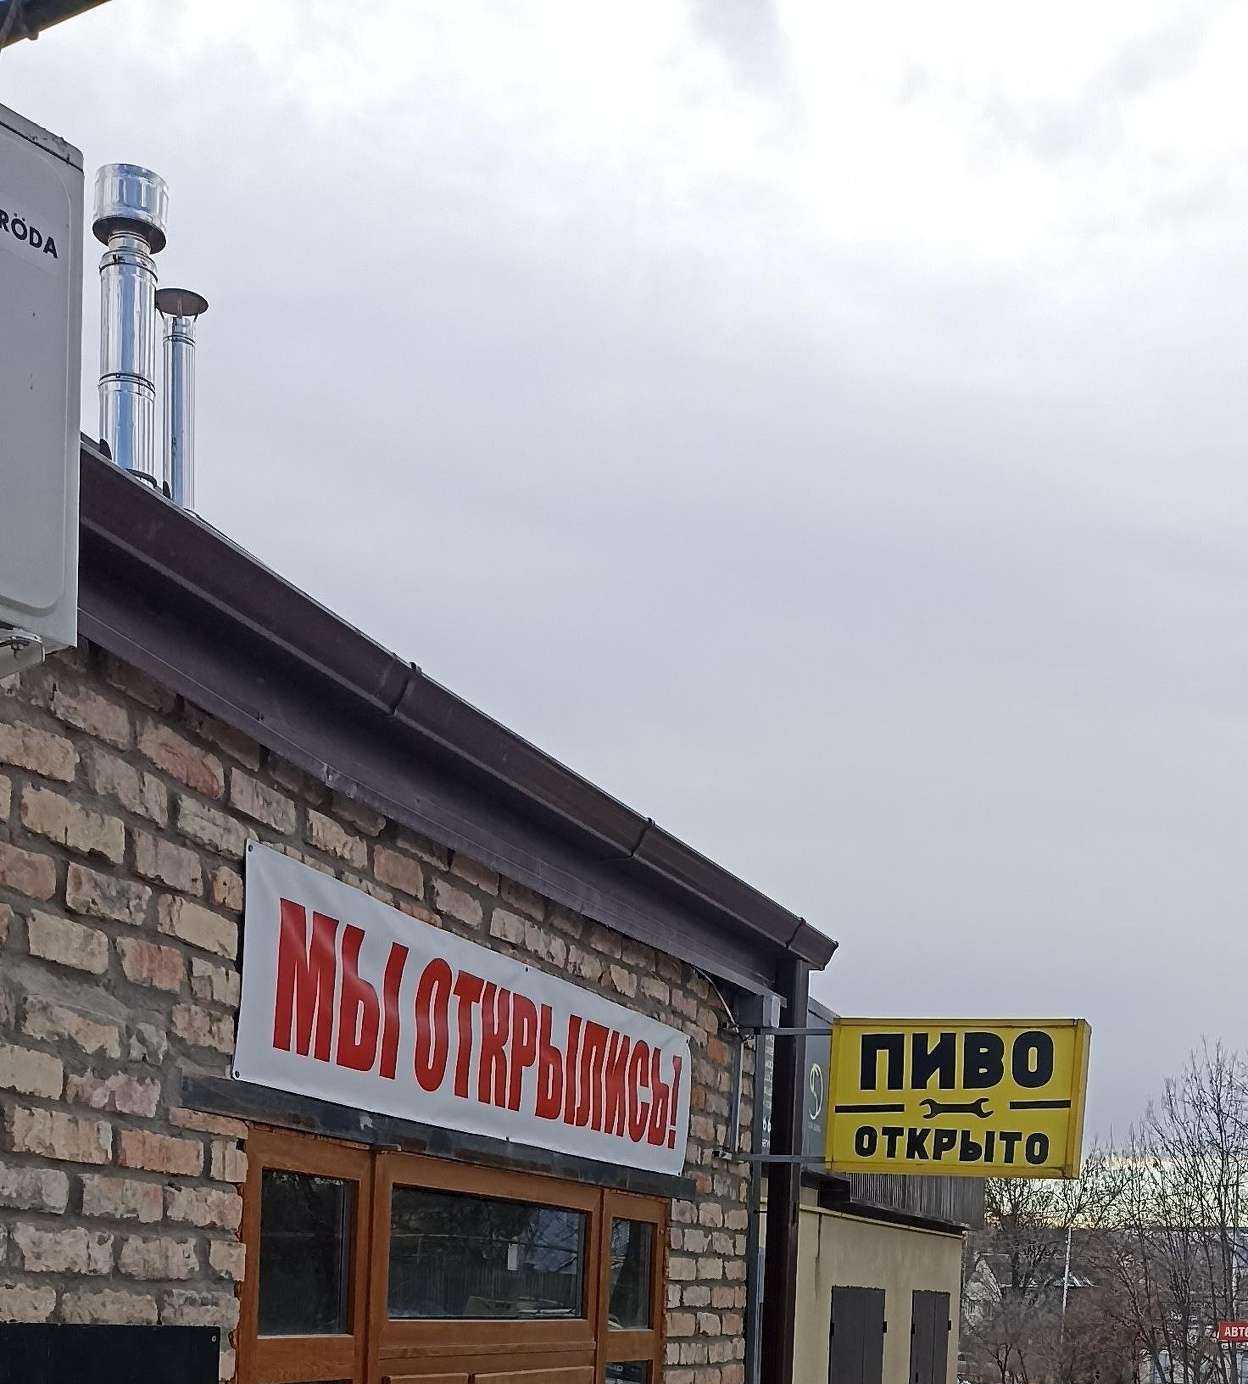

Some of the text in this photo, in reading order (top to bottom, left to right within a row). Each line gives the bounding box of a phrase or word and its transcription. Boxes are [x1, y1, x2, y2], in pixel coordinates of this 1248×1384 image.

[273, 898, 682, 1149] МЫ ОТКРЫЛИСЬ!
[860, 1031, 1053, 1090] ПИВО
[855, 1125, 1049, 1164] ОТКРЫТО
